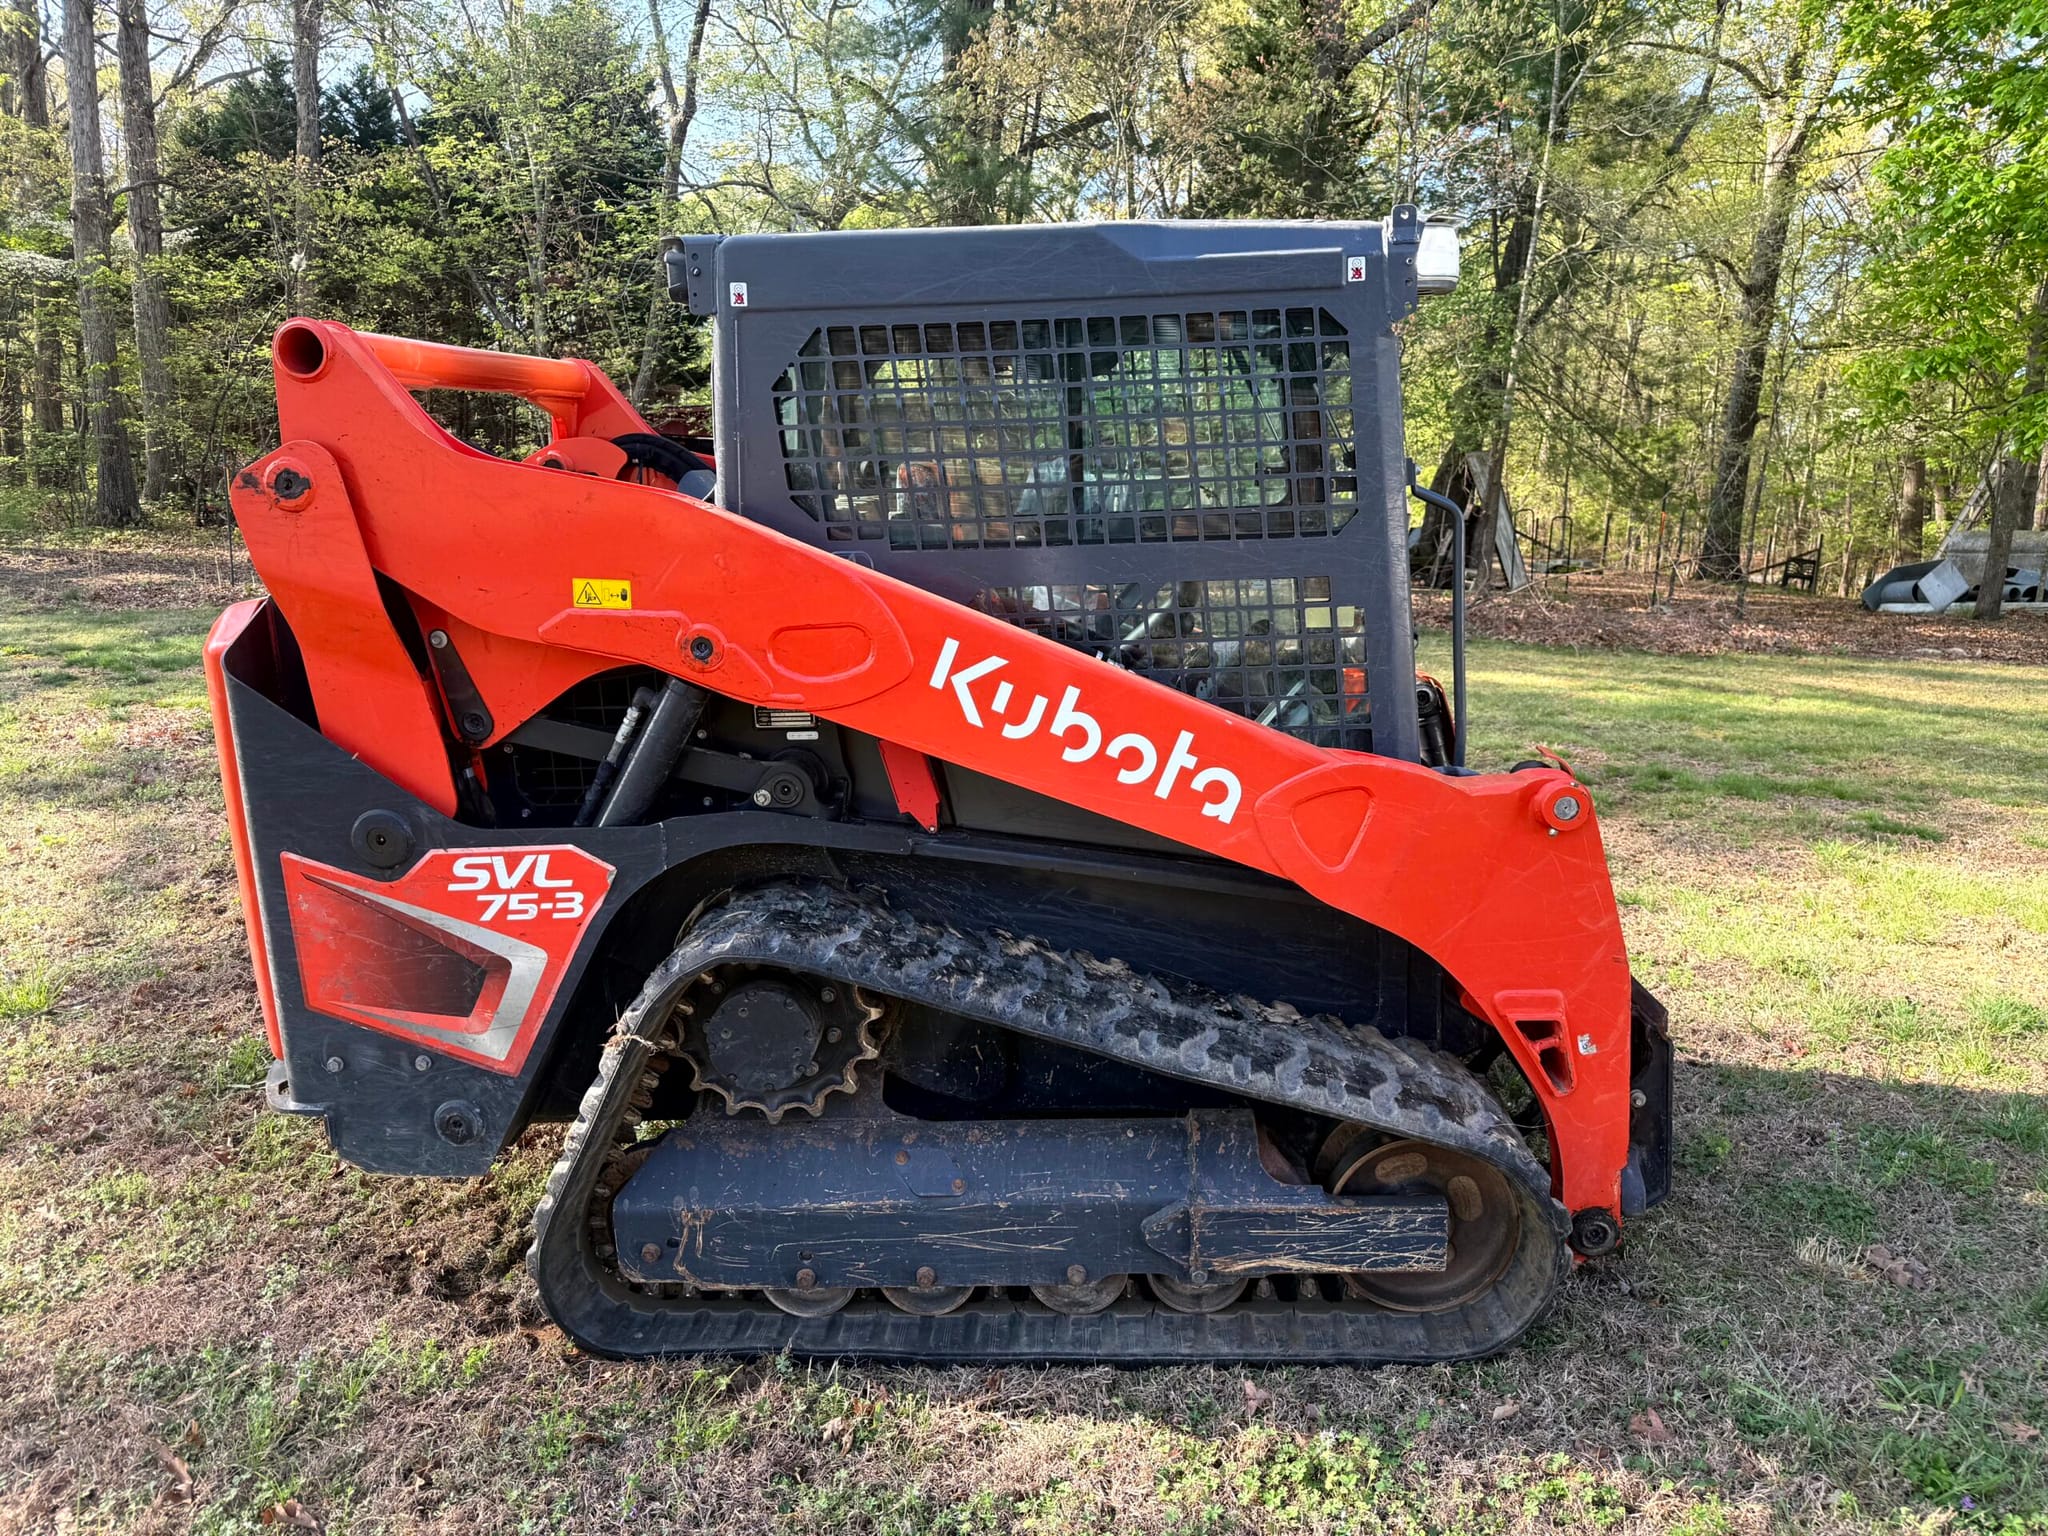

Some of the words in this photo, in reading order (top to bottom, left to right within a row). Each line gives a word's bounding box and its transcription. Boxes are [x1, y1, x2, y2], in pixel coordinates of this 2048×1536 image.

[929, 637, 1242, 824] Kubota
[448, 854, 573, 891] SVL
[477, 892, 584, 921] 75-3
